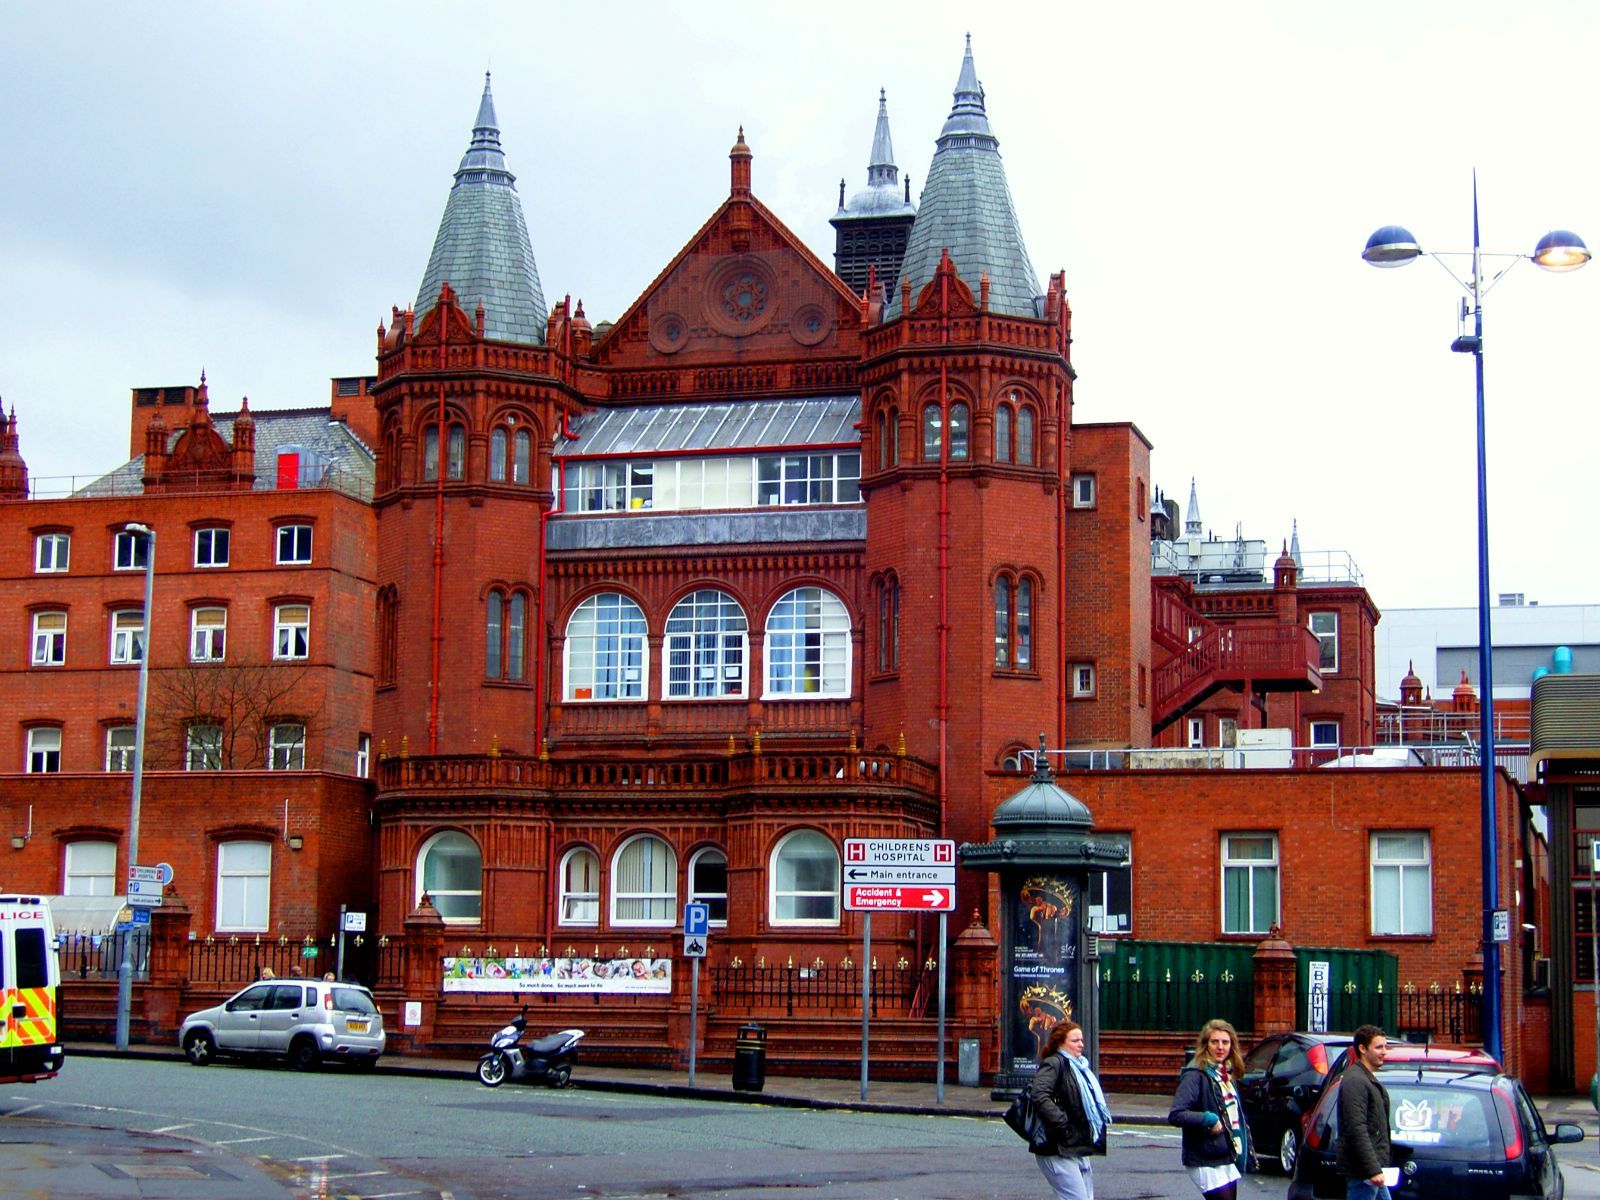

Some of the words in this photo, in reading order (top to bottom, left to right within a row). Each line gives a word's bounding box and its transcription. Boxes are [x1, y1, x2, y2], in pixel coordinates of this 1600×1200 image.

[869, 843, 930, 851] CHILDRENS
[850, 844, 862, 860] H
[936, 845, 949, 861] H
[874, 853, 925, 861] HOSPITAL
[870, 870, 893, 879] Main
[896, 871, 938, 879] entrance
[856, 888, 892, 896] Accident
[855, 897, 902, 907] Emergency
[690, 907, 705, 932] P
[1013, 965, 1031, 973] Game
[1031, 965, 1039, 973] of
[1039, 965, 1065, 974] Thrones
